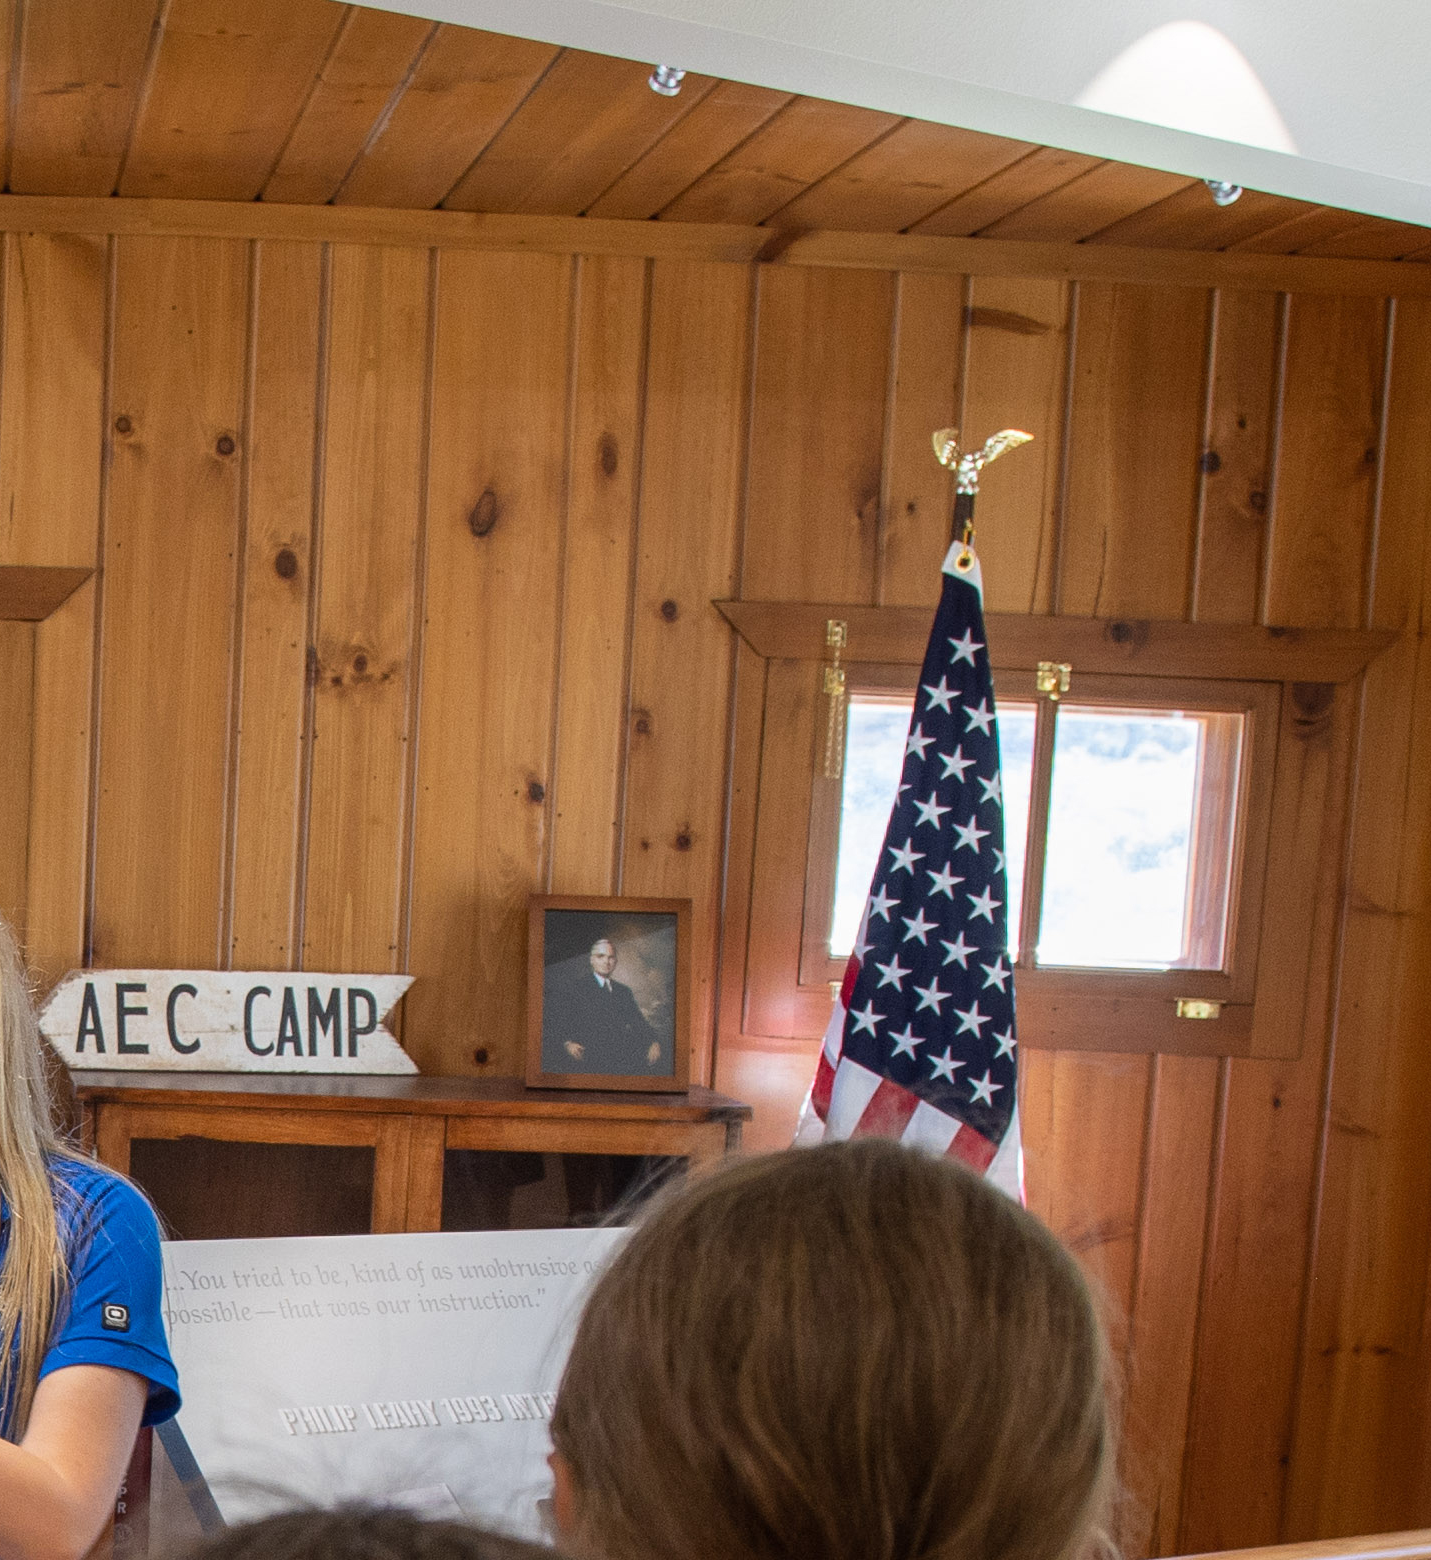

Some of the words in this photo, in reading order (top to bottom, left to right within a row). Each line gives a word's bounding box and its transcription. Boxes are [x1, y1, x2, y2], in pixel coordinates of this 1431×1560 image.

[75, 982, 202, 1055] AEC
[243, 985, 379, 1058] CAMP
[233, 1265, 284, 1290] tried
[290, 1267, 313, 1287] to
[315, 1264, 349, 1288] be,
[351, 1262, 401, 1284] kind
[406, 1260, 425, 1288] of
[431, 1265, 453, 1281] as
[458, 1256, 578, 1280] unobtrusive
[327, 1301, 370, 1318] was
[376, 1300, 411, 1316] our
[278, 1405, 357, 1436] PHILIP
[361, 1399, 442, 1430] LEAHY
[441, 1395, 504, 1424] 1993
